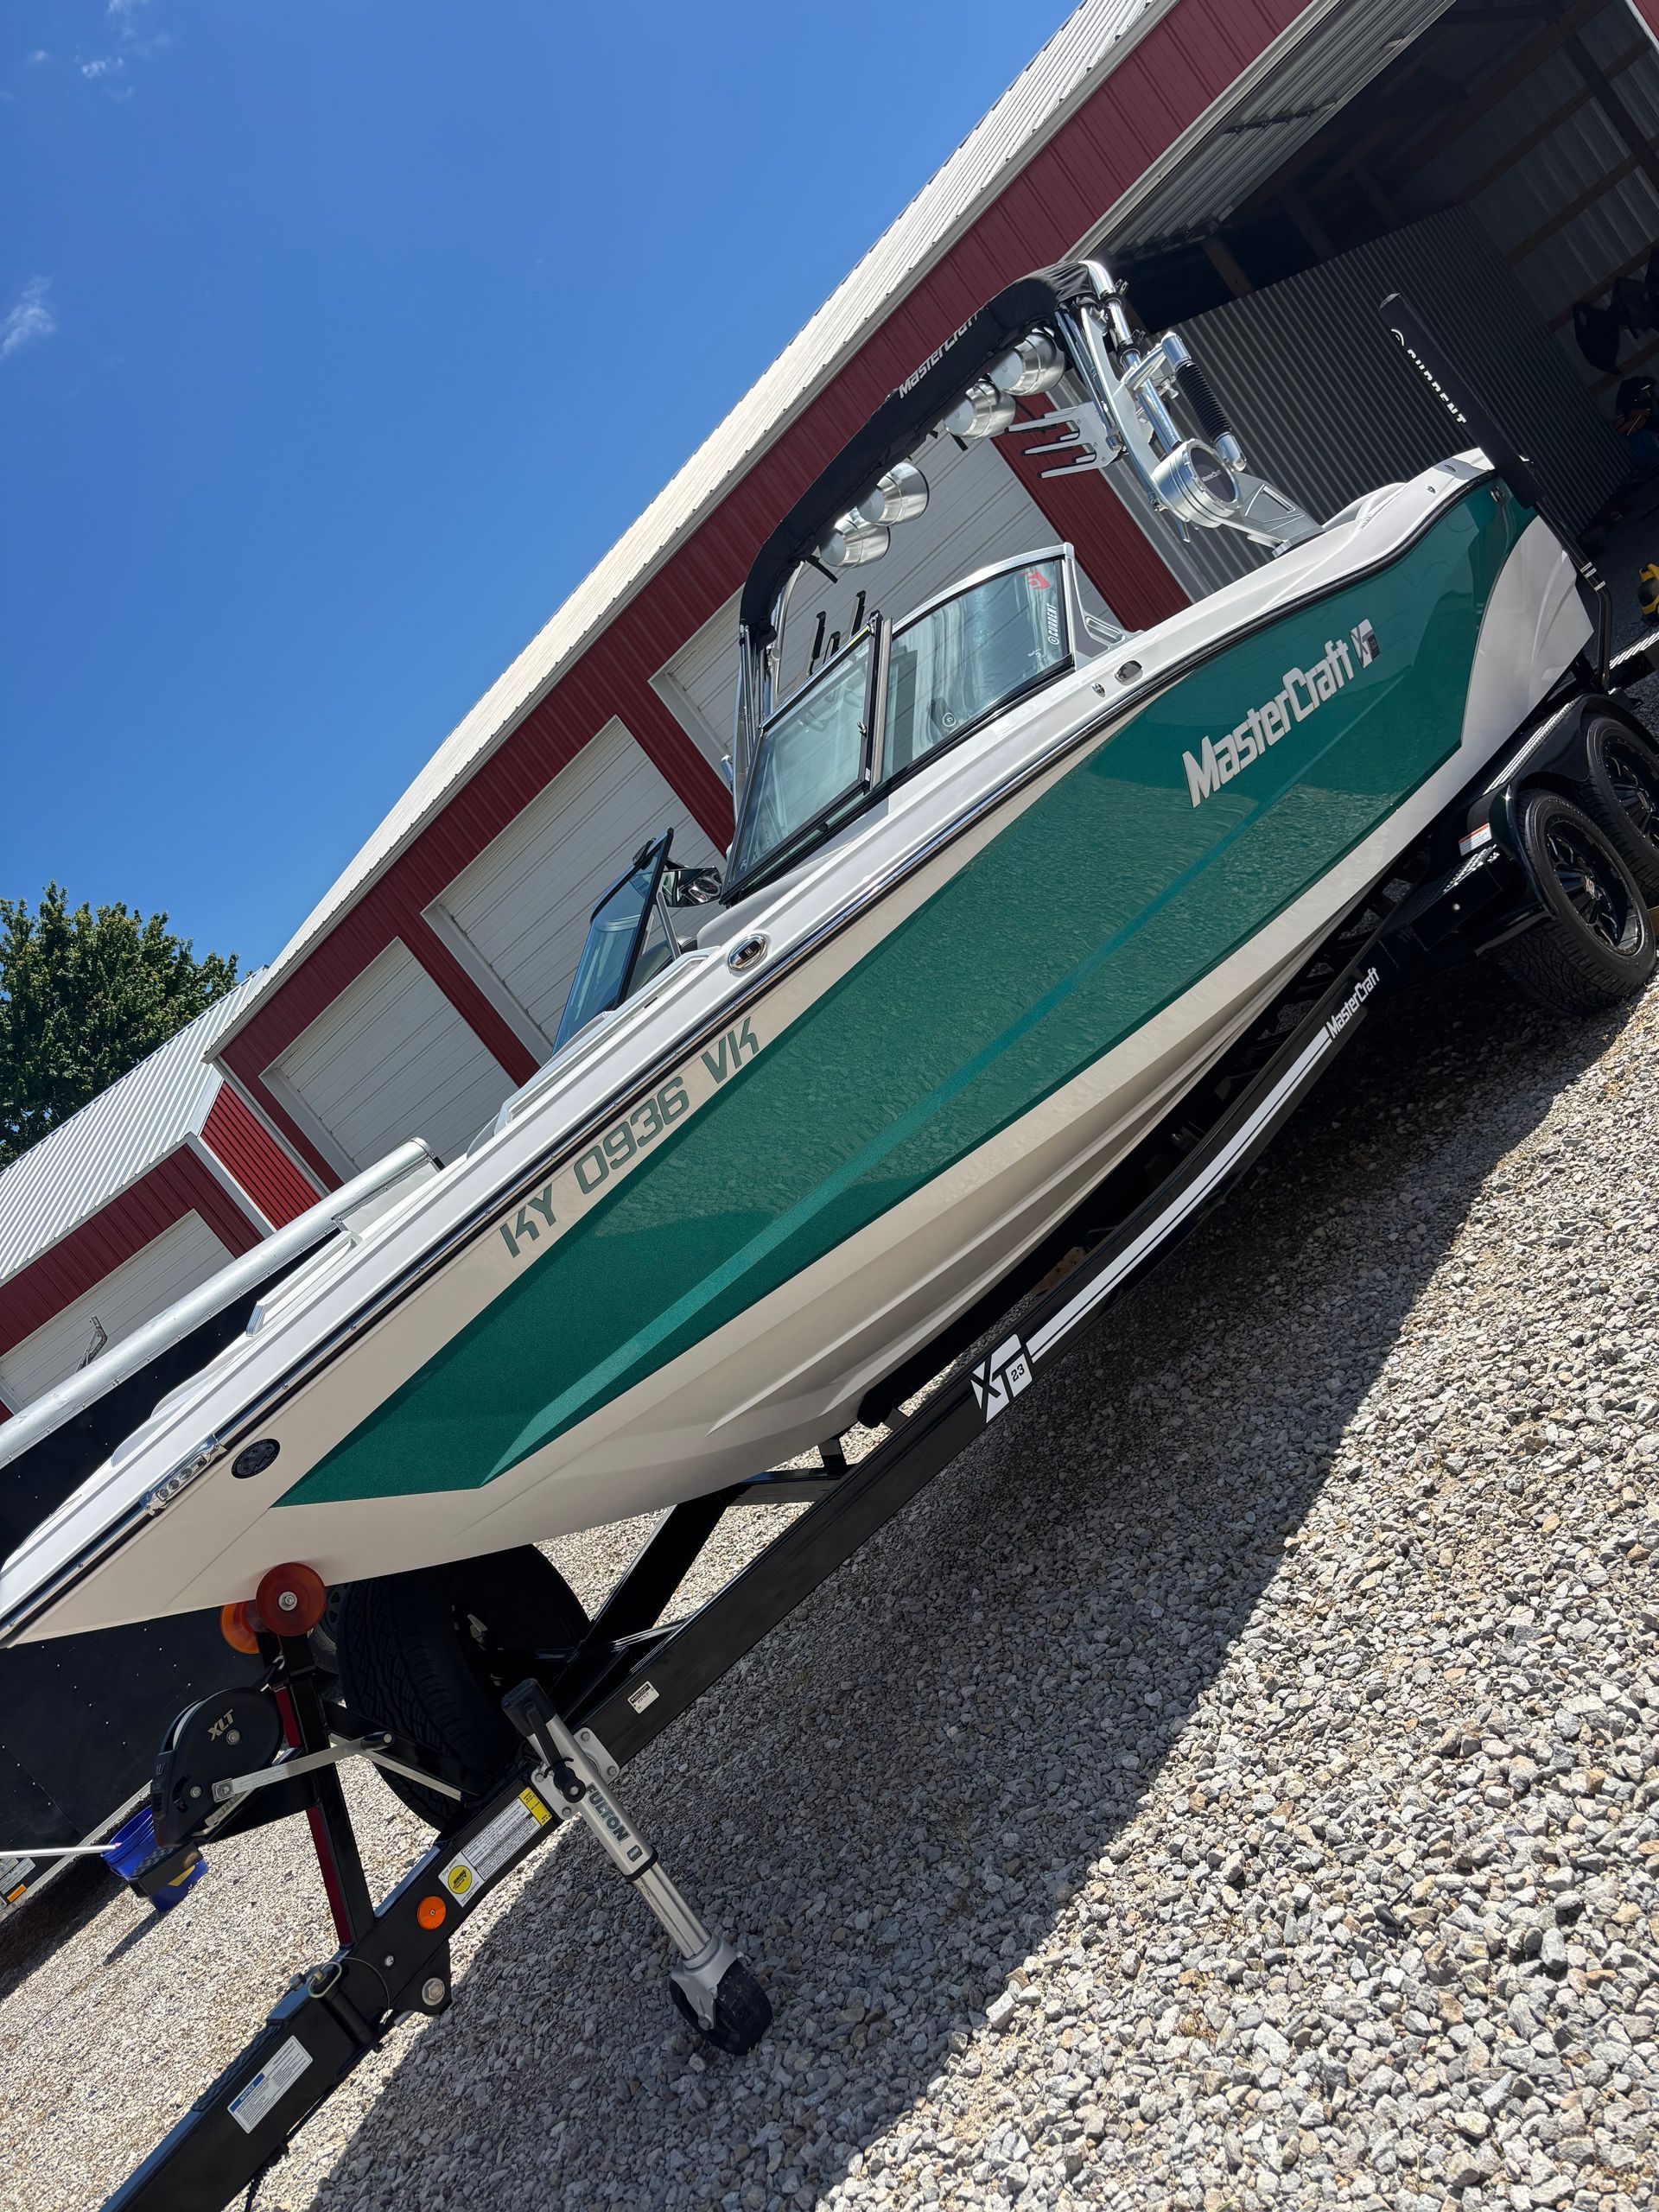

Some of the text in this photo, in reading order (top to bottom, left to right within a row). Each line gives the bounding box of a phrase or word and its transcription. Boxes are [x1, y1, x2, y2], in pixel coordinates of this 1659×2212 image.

[1046, 602, 1058, 637] CURRENT
[1181, 639, 1354, 809] MasterCraft
[1325, 966, 1380, 1039] MasterCraft
[499, 1015, 760, 1259] KY 0936 VK
[969, 1344, 1027, 1423] XT 23
[207, 1708, 235, 1742] XLT
[585, 1782, 631, 1843] FULTON
[238, 2083, 256, 2102] NOTICE
